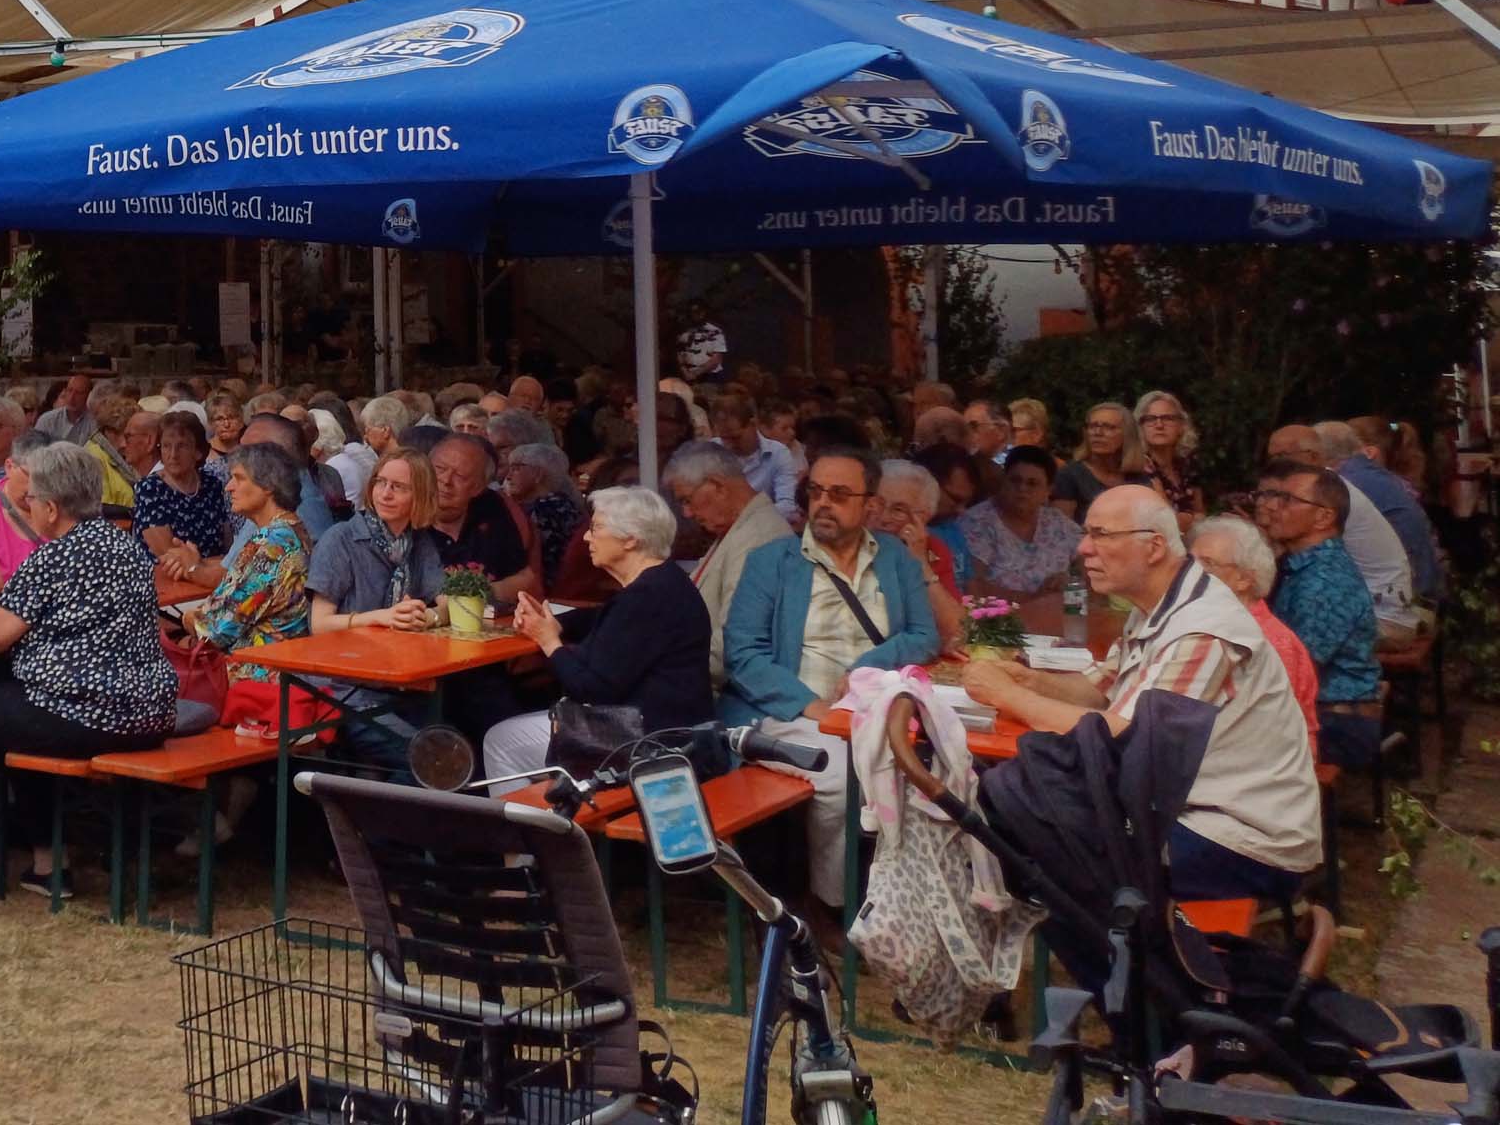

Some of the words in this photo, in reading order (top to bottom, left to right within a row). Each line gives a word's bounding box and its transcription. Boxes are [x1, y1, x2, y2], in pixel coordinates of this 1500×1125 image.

[86, 143, 159, 175] Faust.
[166, 134, 219, 166] Das
[224, 122, 304, 161] bleibt
[311, 125, 389, 155] unter
[396, 125, 460, 152] uns.
[1150, 120, 1204, 159] Faust.
[1203, 125, 1236, 161] Das
[1237, 126, 1280, 168] bleibt
[1282, 147, 1330, 178] unter
[1332, 156, 1364, 186] uns.
